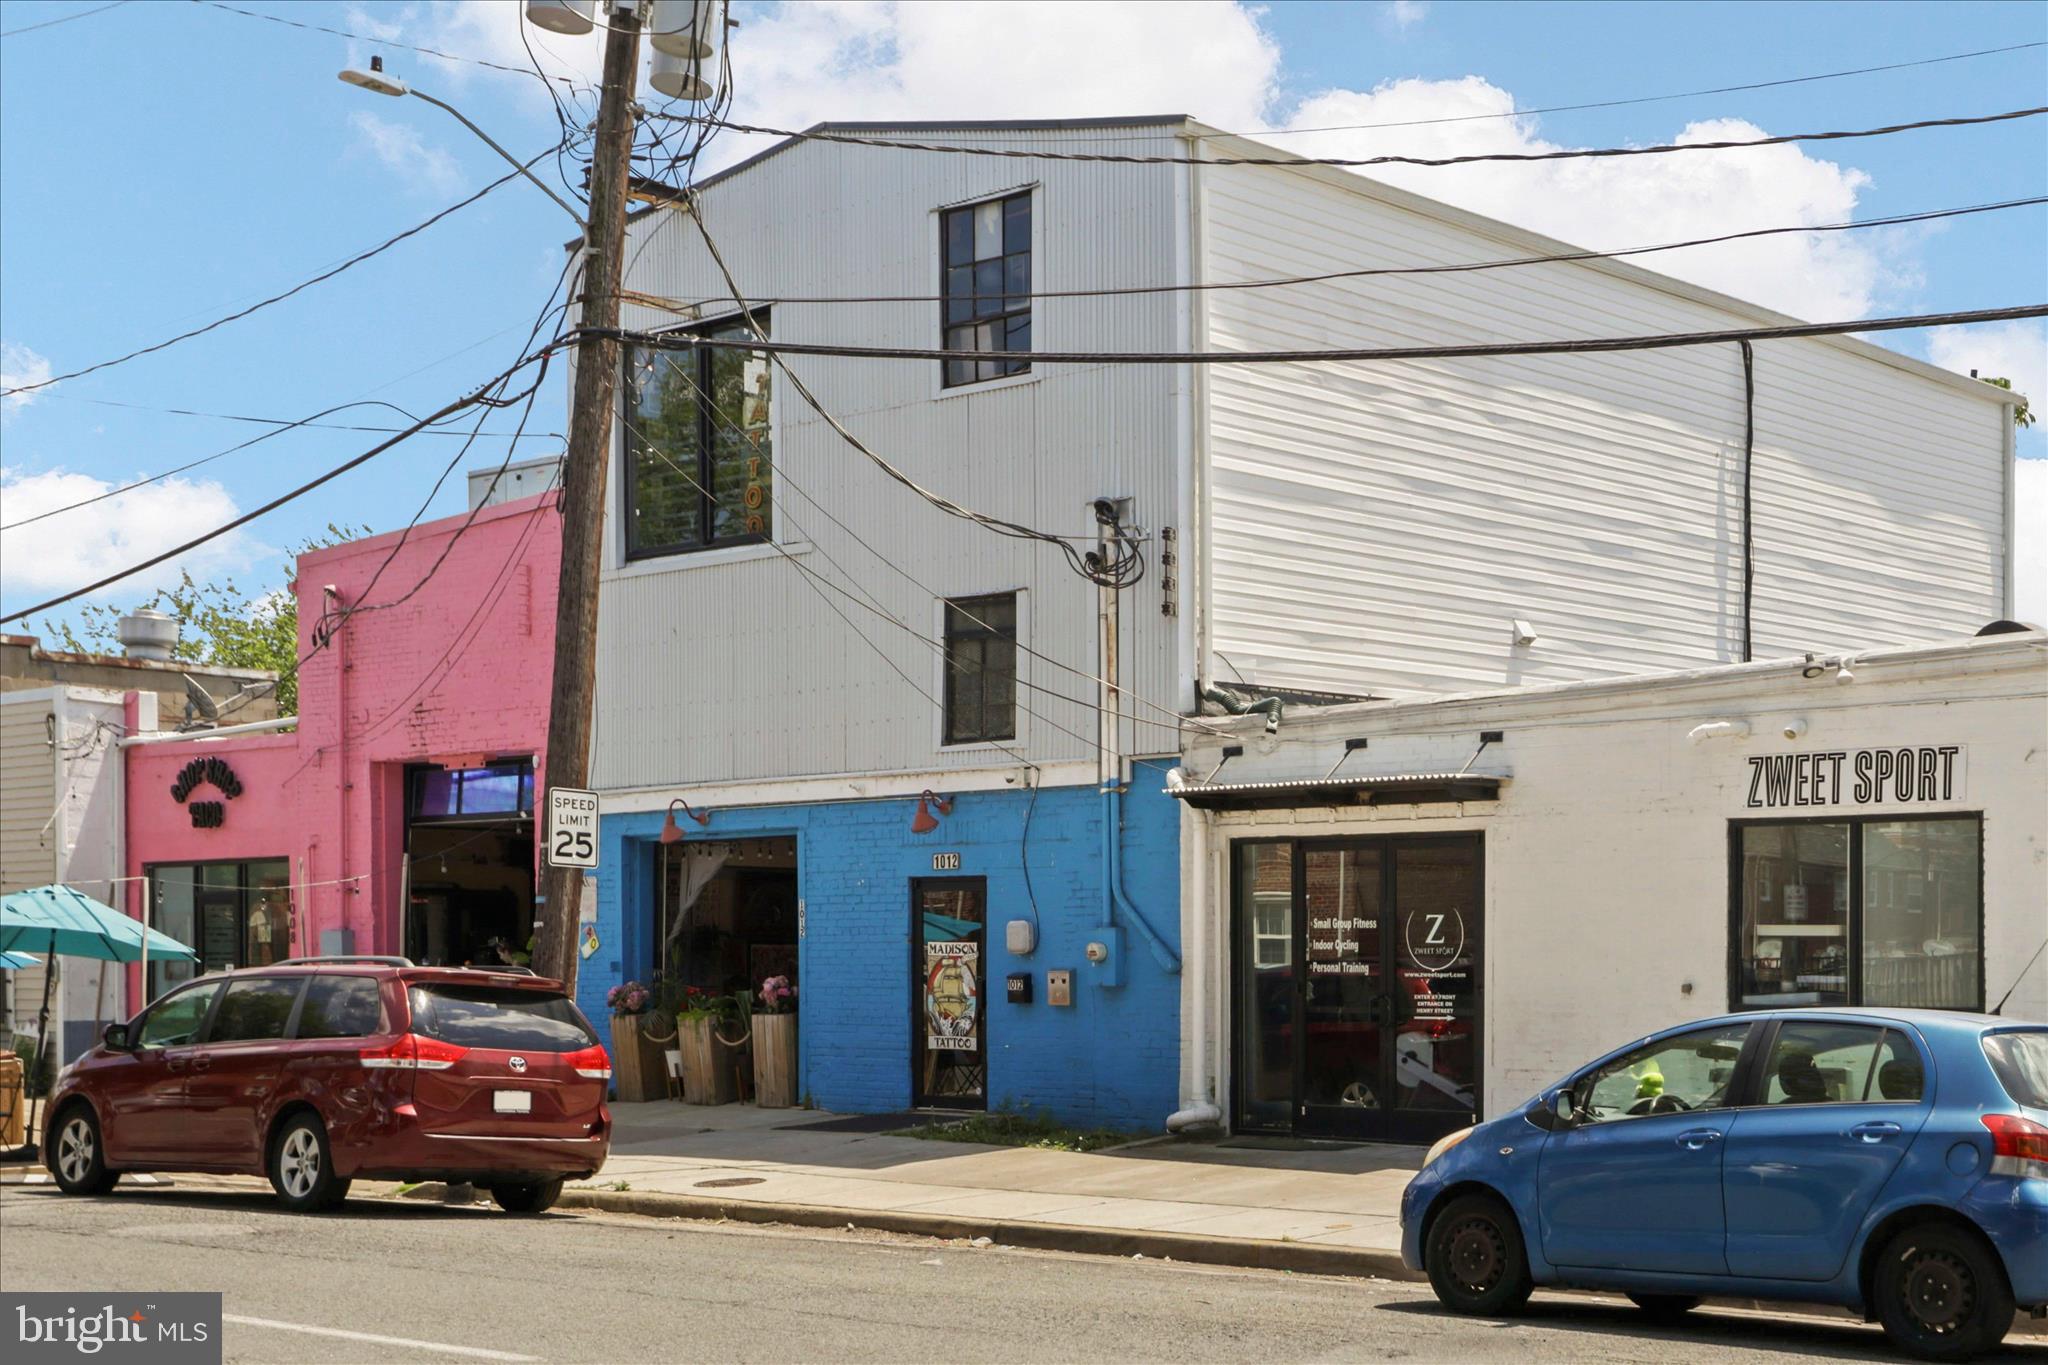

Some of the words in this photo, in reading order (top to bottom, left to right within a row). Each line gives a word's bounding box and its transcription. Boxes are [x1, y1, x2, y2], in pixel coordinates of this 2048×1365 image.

[1747, 752, 1847, 808] ZWEET
[1854, 746, 1959, 803] SPORT
[554, 797, 595, 811] SPEED
[559, 814, 590, 827] LIMIT
[555, 830, 593, 859] 25
[934, 854, 959, 869] 1012
[288, 889, 297, 944] 1008
[1313, 918, 1331, 929] Small
[1332, 917, 1352, 931] Group
[1353, 917, 1377, 929] Fitness
[1425, 913, 1445, 944] Z
[929, 943, 976, 955] MADISON
[1312, 939, 1334, 950] Indoor
[1334, 939, 1359, 953] Cycling
[1414, 947, 1434, 955] ZWEET
[1312, 962, 1341, 972] Personal
[1342, 961, 1369, 976] Training
[1008, 979, 1024, 991] 1012
[933, 1037, 972, 1049] TATTOO
